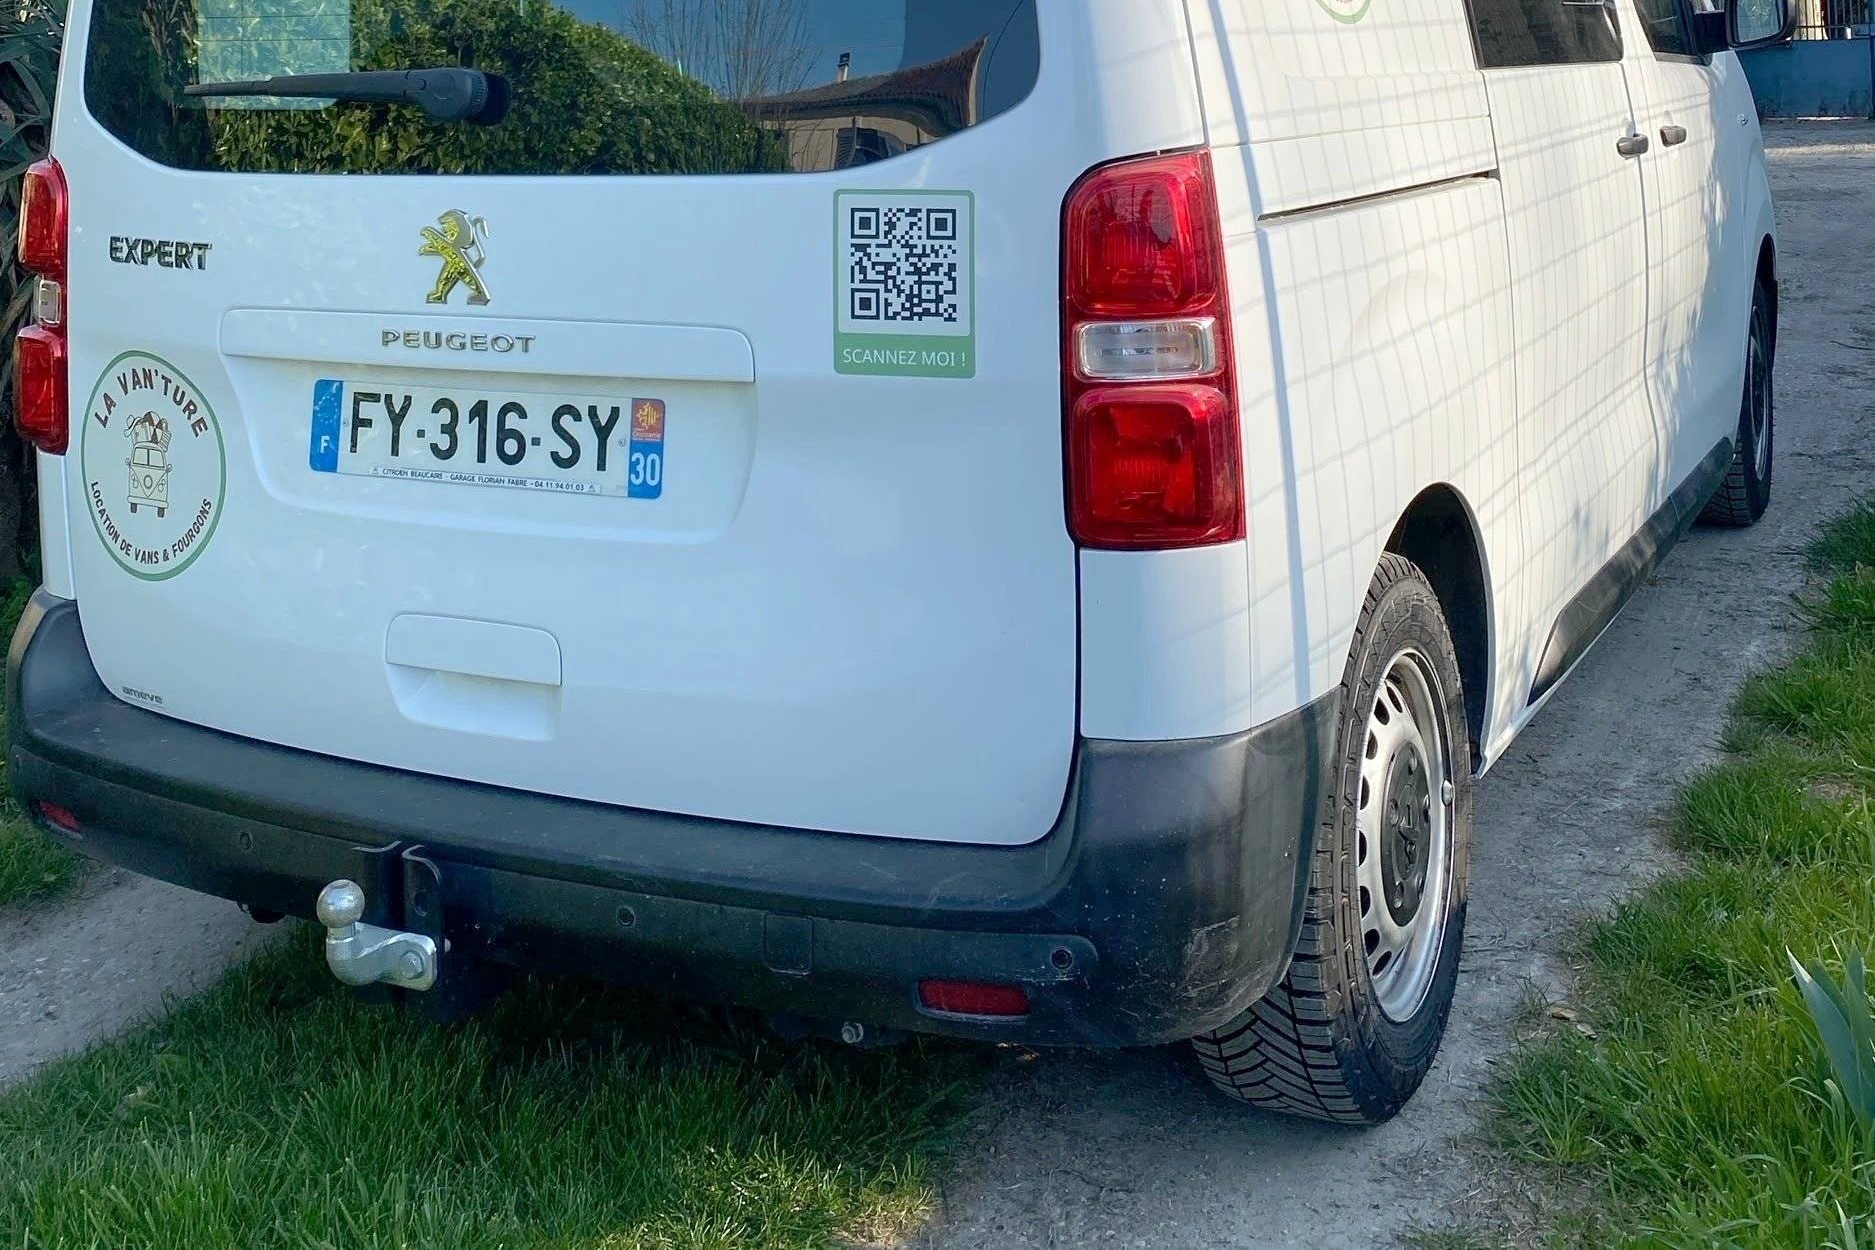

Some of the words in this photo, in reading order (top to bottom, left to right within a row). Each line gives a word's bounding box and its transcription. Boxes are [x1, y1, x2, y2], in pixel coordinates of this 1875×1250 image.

[110, 236, 212, 271] EXPERT
[382, 329, 536, 354] PEUGEOT
[843, 349, 917, 365] SCANNEZ
[922, 351, 956, 367] MOI
[961, 352, 966, 367] !
[94, 392, 117, 429] LA
[117, 367, 209, 438] VAN'TURE
[319, 435, 331, 454] F
[410, 470, 443, 479] BEAUCAIRE
[450, 473, 475, 483] GARAGE
[477, 475, 505, 485] FLORIAN
[508, 478, 528, 487] FABRE
[534, 480, 543, 488] 04
[546, 481, 553, 489] 11
[555, 482, 563, 490] 94
[630, 452, 660, 486] 30
[91, 481, 120, 544] LOCATION
[120, 538, 133, 557] DE
[134, 547, 159, 565] VANS
[162, 548, 170, 562] &
[171, 498, 212, 558] FOURGONS
